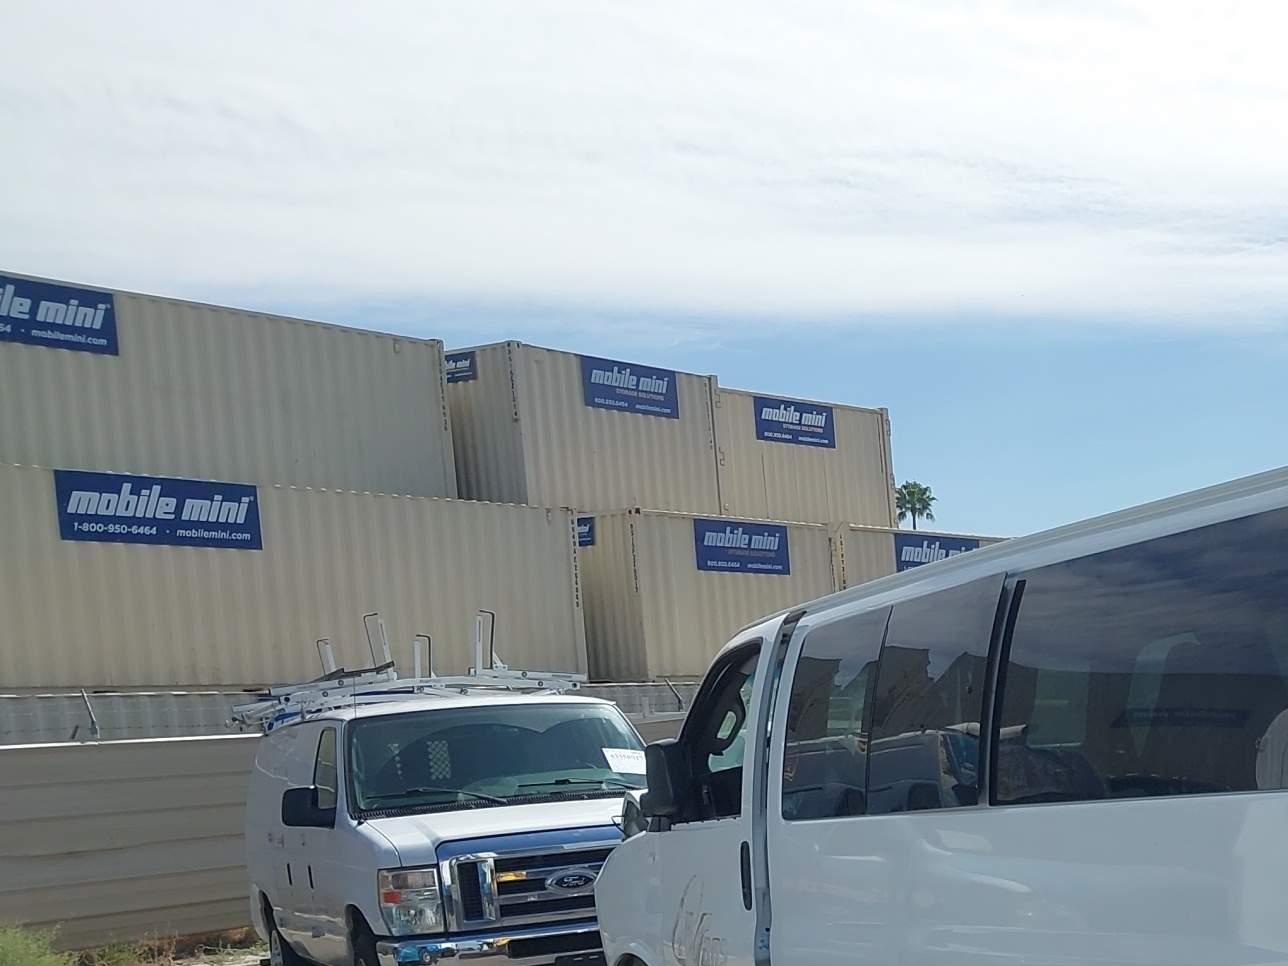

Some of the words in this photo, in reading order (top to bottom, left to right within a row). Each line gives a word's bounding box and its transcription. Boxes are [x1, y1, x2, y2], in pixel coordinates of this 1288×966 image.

[36, 299, 105, 329] mini
[590, 366, 637, 389] mobile
[638, 375, 669, 394] mini
[761, 404, 800, 424] mobile
[801, 410, 827, 428] mini
[65, 483, 175, 520] mobile
[181, 495, 251, 524] mini
[73, 522, 157, 536] 1-800-950-6464
[176, 528, 251, 541] mobilemini.com
[704, 526, 749, 549] mobile
[750, 532, 780, 551] mini
